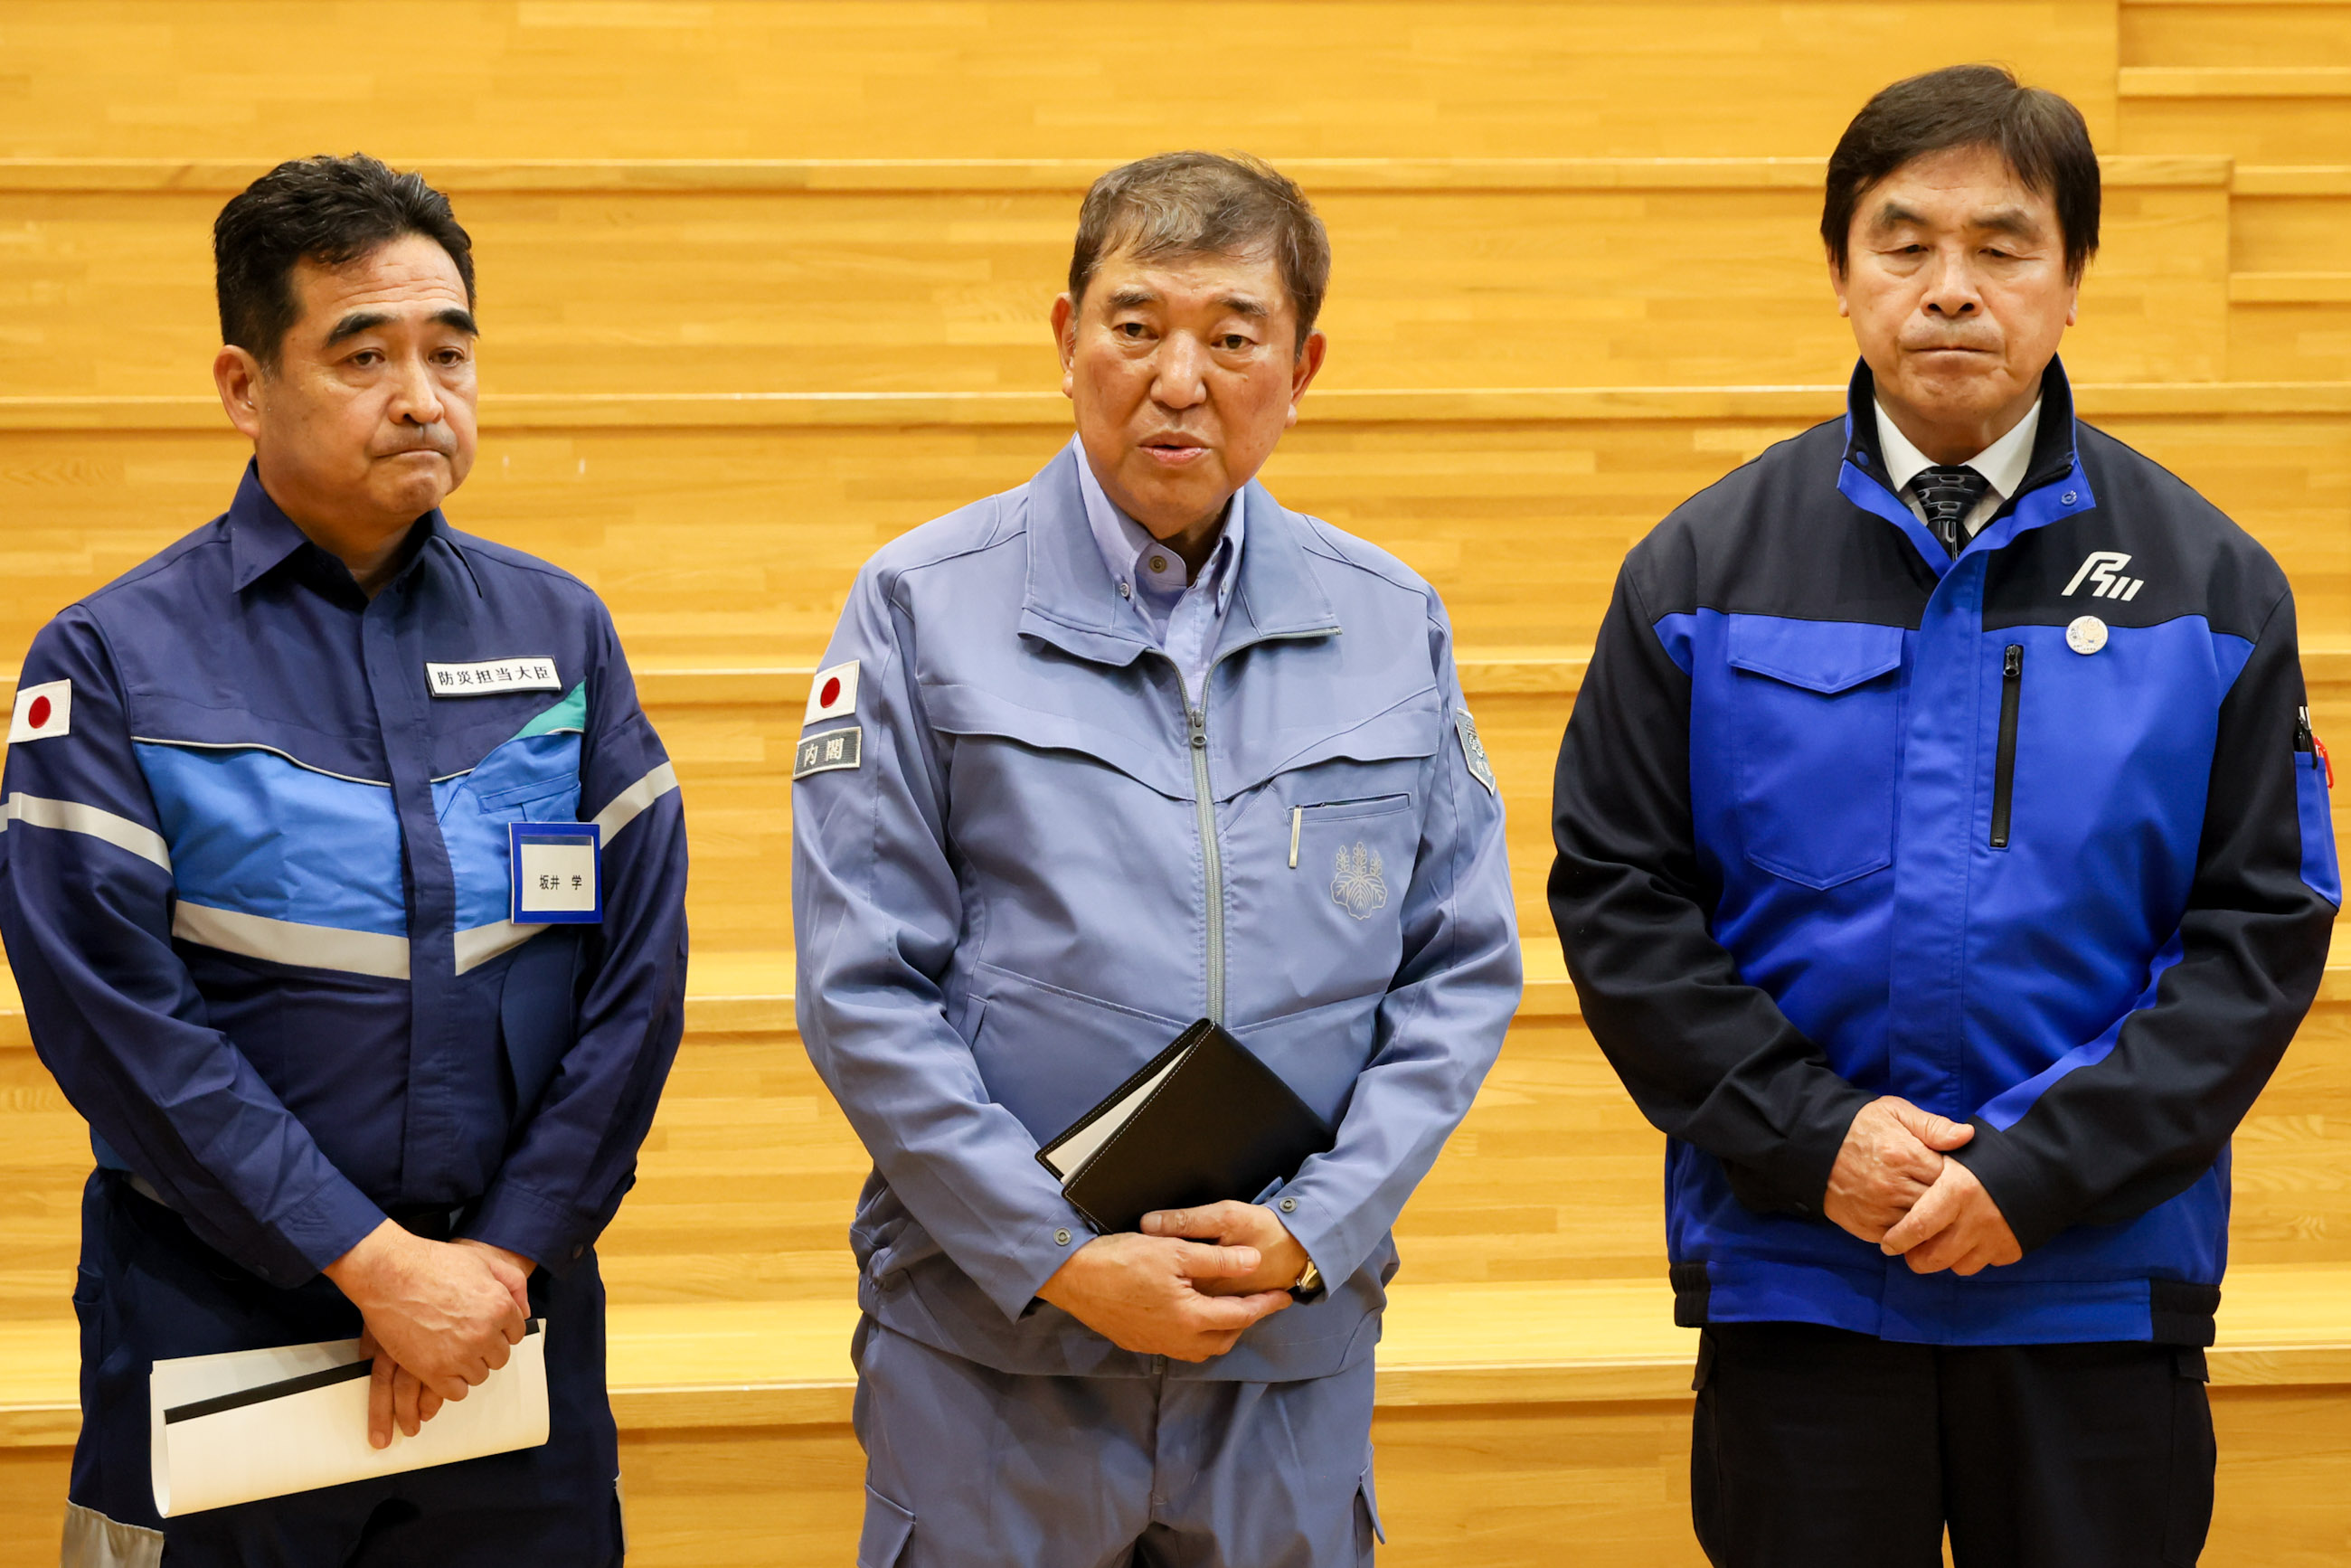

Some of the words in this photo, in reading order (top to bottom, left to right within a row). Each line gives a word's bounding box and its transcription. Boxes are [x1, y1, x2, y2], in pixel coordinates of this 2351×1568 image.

[437, 666, 551, 686] 防災担当大臣
[804, 737, 845, 768] 内閣
[539, 874, 560, 890] 坂井
[571, 874, 582, 891] 学
